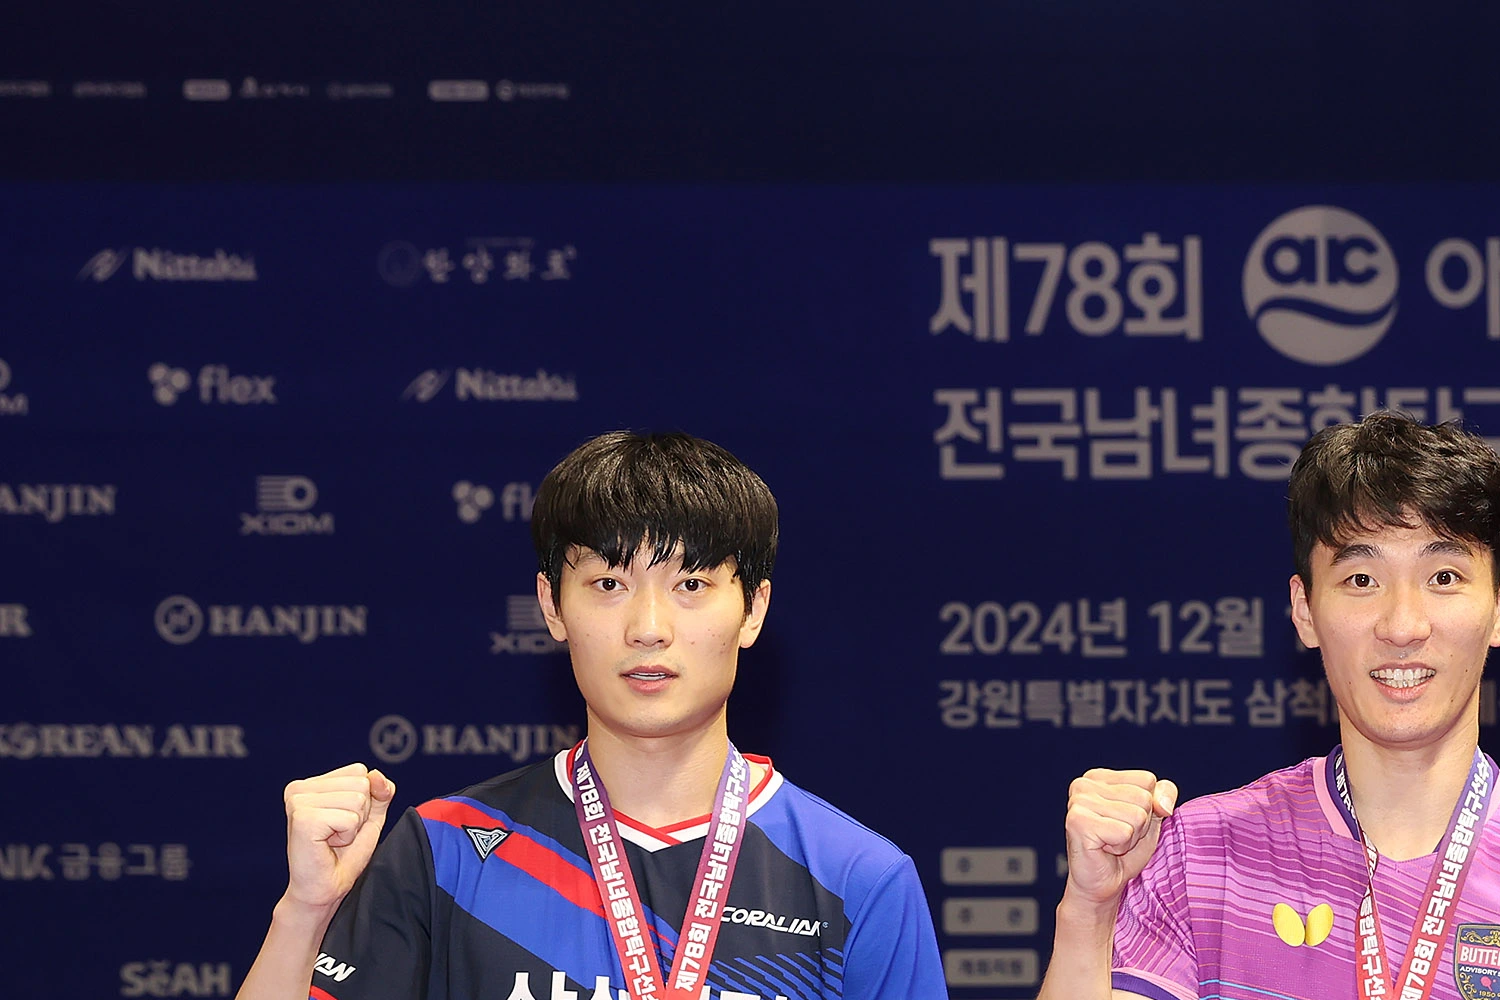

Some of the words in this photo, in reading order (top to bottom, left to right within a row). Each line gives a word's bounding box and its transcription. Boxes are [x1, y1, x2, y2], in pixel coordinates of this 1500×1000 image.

[929, 232, 1201, 341] 제78회
[198, 364, 277, 405] flex
[208, 604, 368, 643] HANJIN
[940, 598, 1127, 657] 2024년
[1149, 597, 1264, 657] 12월
[940, 679, 1234, 727] 강원특별자치도
[160, 724, 249, 757] AIR
[423, 725, 579, 761] HANJIN
[575, 760, 606, 822] 제78회
[676, 924, 712, 991] 제78회
[1459, 966, 1497, 977] ADVISORY
